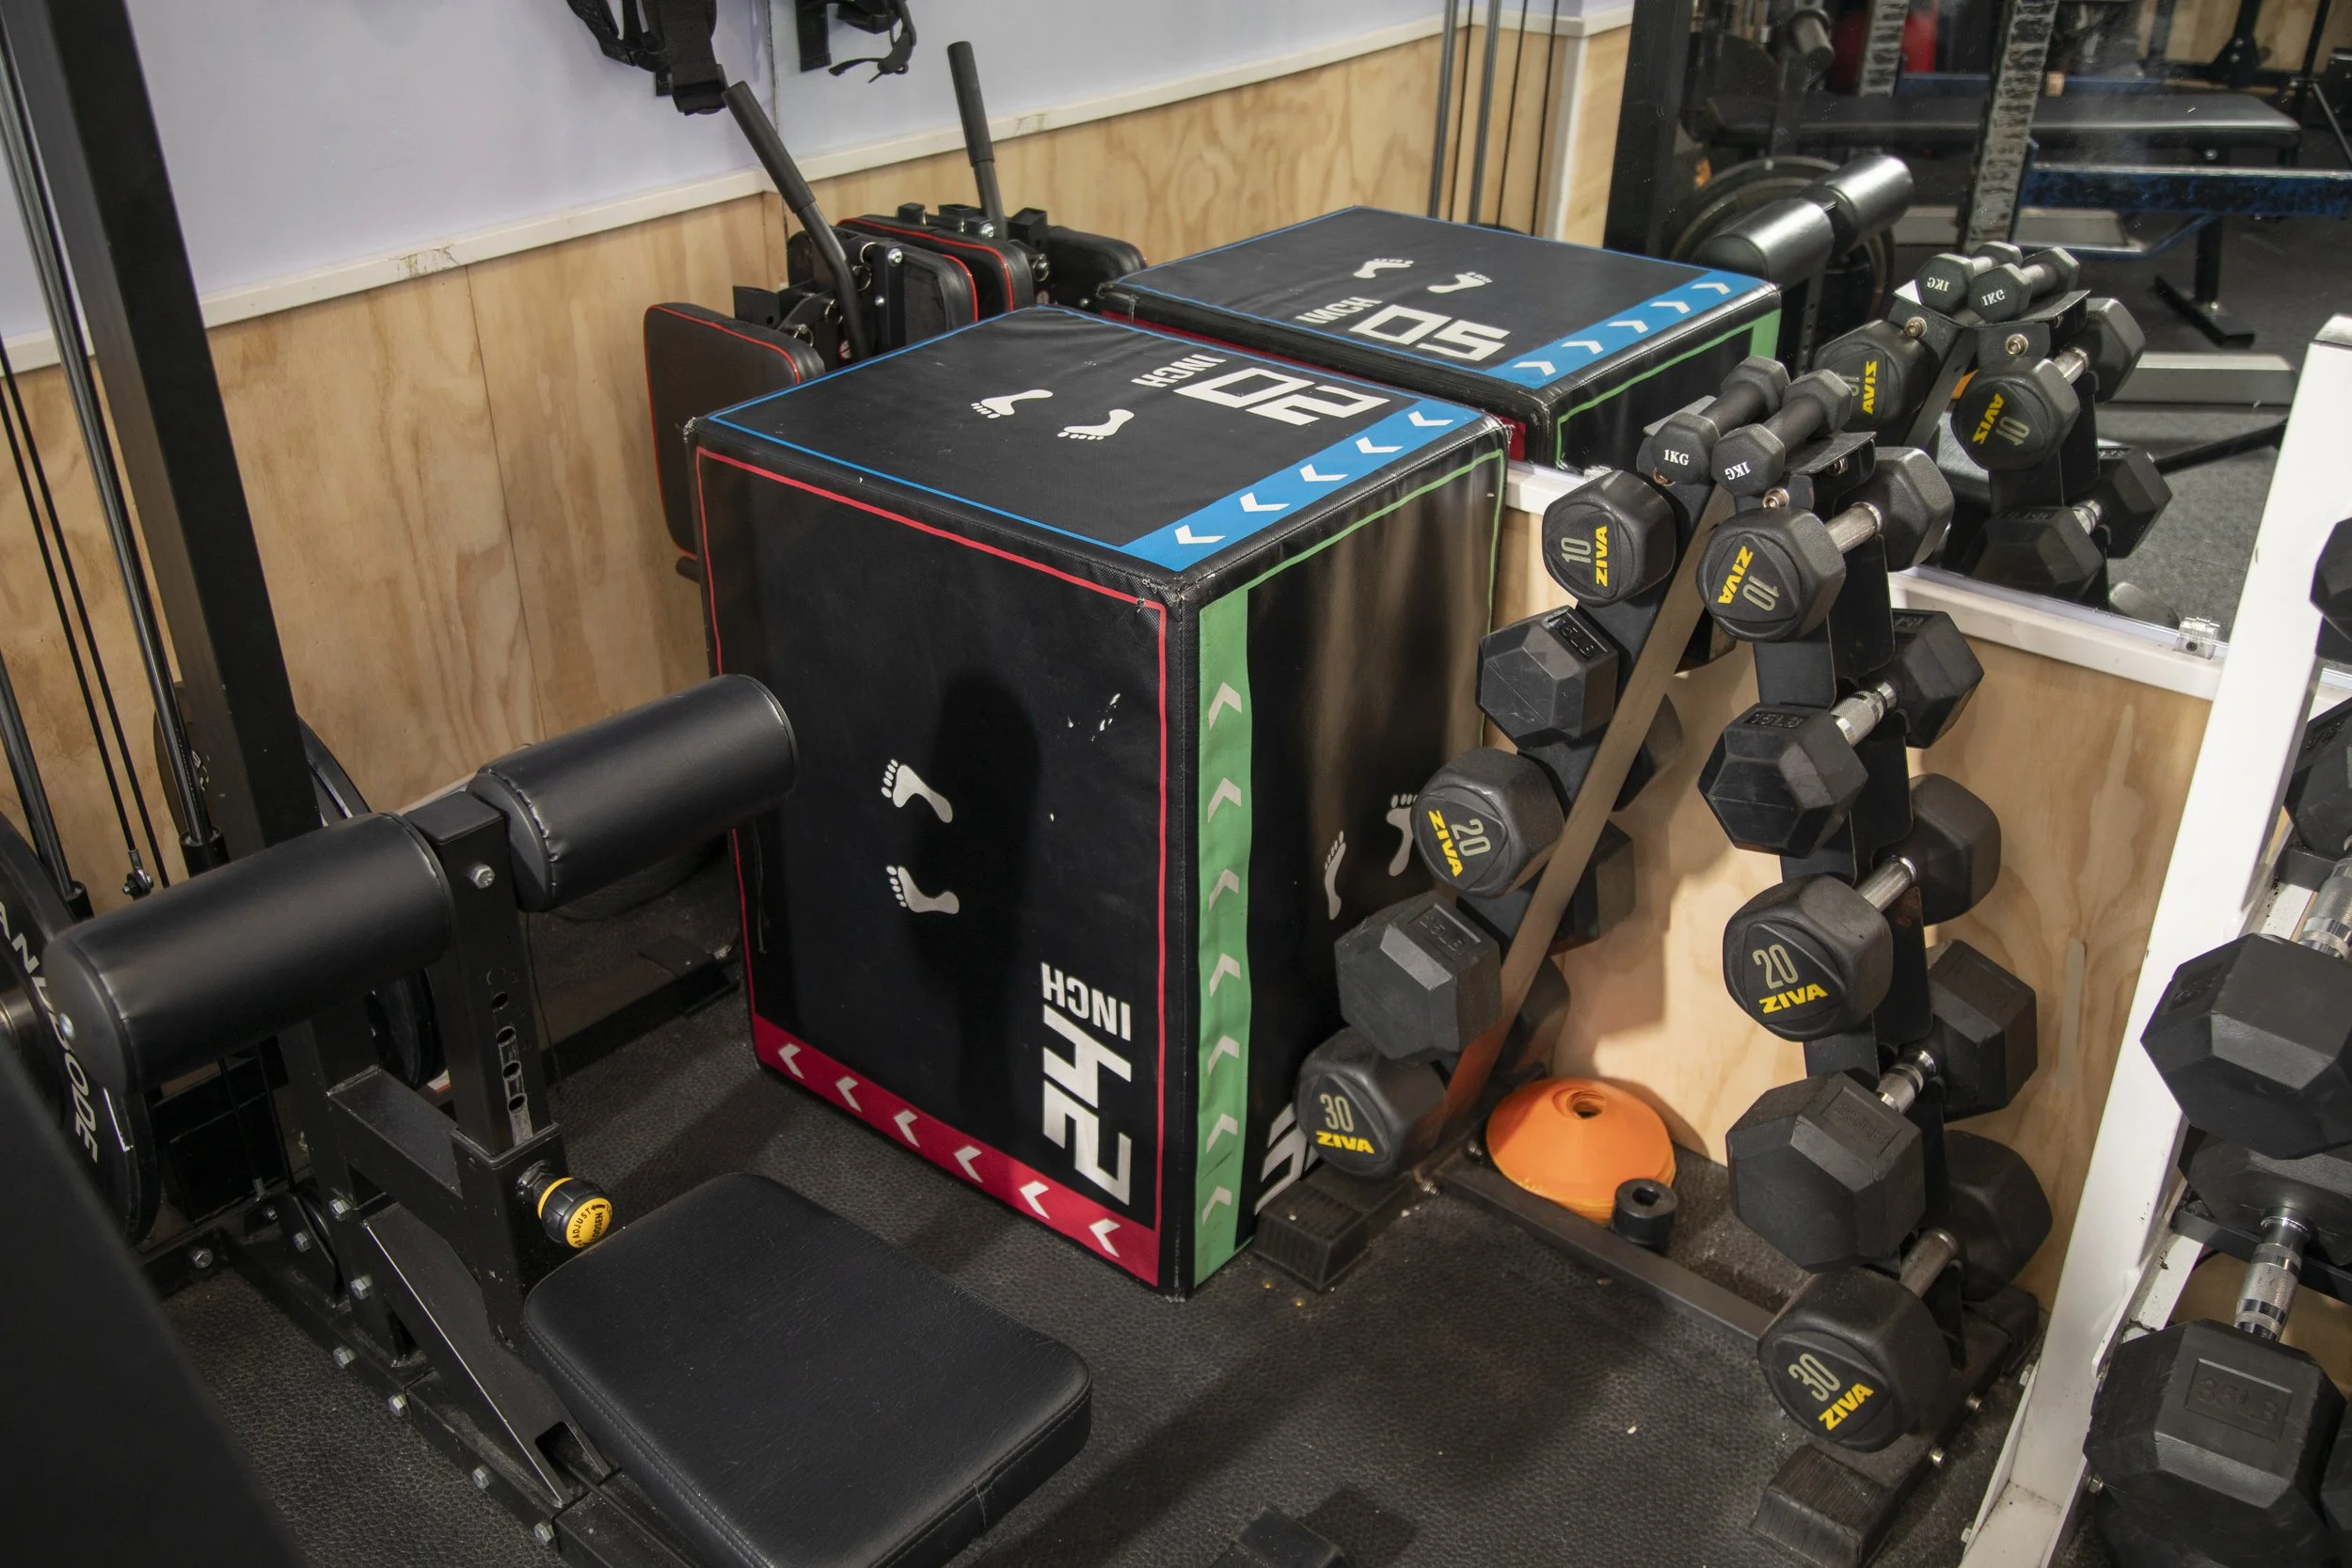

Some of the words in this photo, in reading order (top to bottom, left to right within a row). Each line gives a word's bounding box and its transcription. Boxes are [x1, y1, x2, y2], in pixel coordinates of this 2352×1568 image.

[1131, 354, 1227, 388] INCH
[1663, 449, 1690, 467] 1KG
[1724, 461, 1752, 481] 1KG
[1561, 537, 1592, 563] 10
[1596, 526, 1608, 588] ZIVA
[1717, 546, 1754, 604] ZIVA
[1742, 575, 1780, 611] 10
[1428, 810, 1464, 878] ZIVA
[1451, 818, 1491, 857] 20
[1752, 944, 1799, 990] 20
[1041, 961, 1132, 1042] INCH
[1758, 983, 1829, 1014] ZIVA
[1043, 1003, 1132, 1206] 24
[1319, 1093, 1355, 1132] 30
[1316, 1131, 1375, 1154] ZIVA
[1788, 1353, 1841, 1402] 30
[1818, 1383, 1875, 1431] ZIVA
